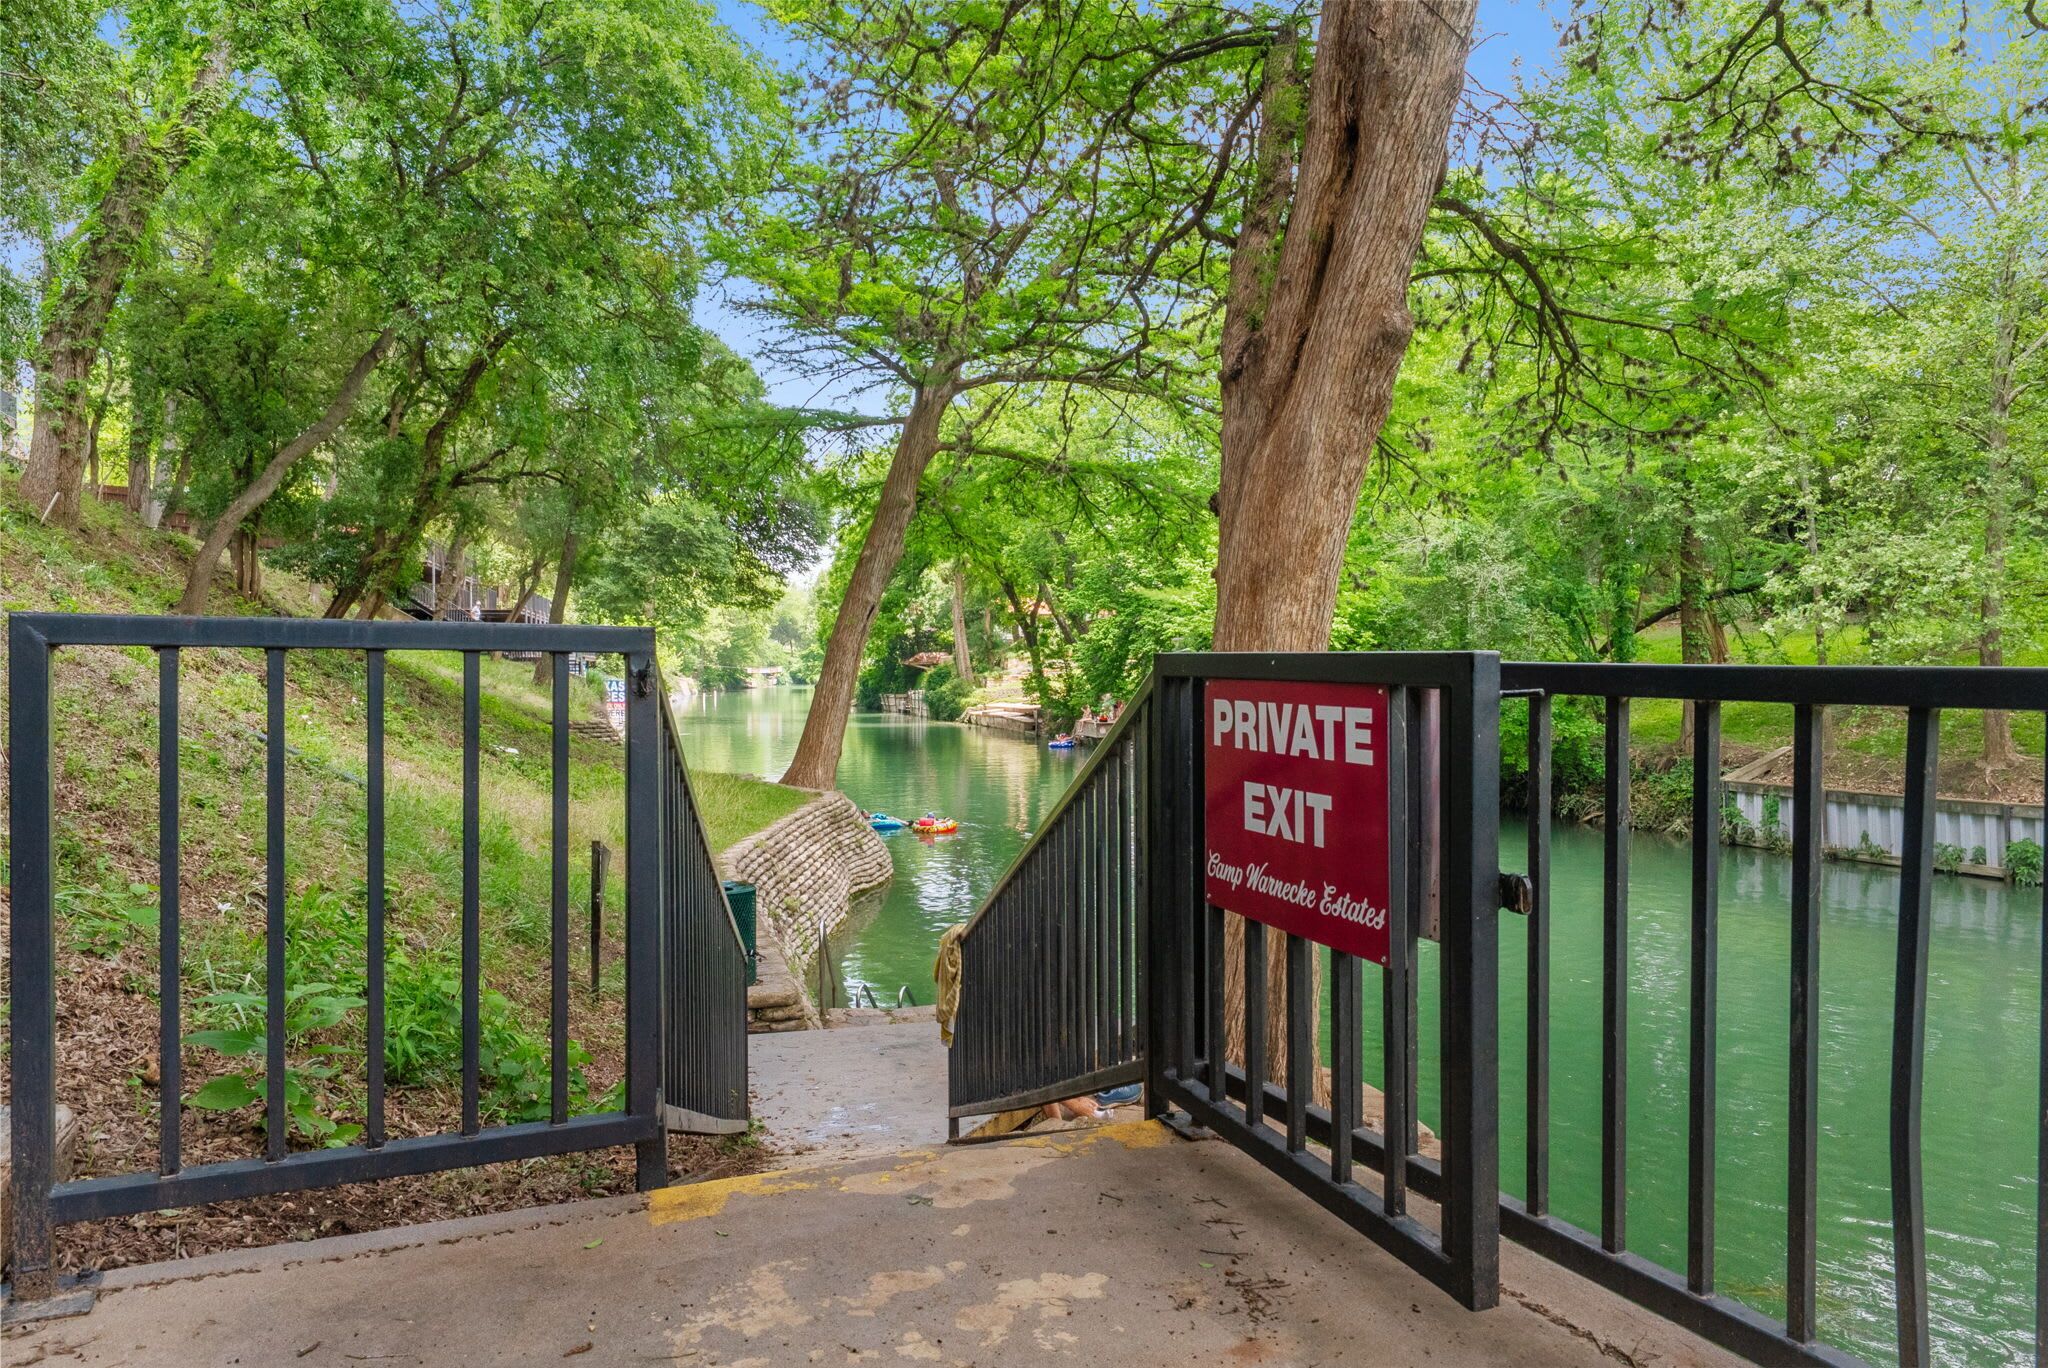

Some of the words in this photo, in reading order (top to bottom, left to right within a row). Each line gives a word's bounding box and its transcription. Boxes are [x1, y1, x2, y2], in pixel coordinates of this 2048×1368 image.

[1213, 698, 1374, 766] PRIVATE
[1243, 780, 1332, 848] EXIT
[1207, 849, 1243, 891] Camp
[1246, 862, 1316, 909] Warnecke
[1319, 881, 1386, 930] Estates
